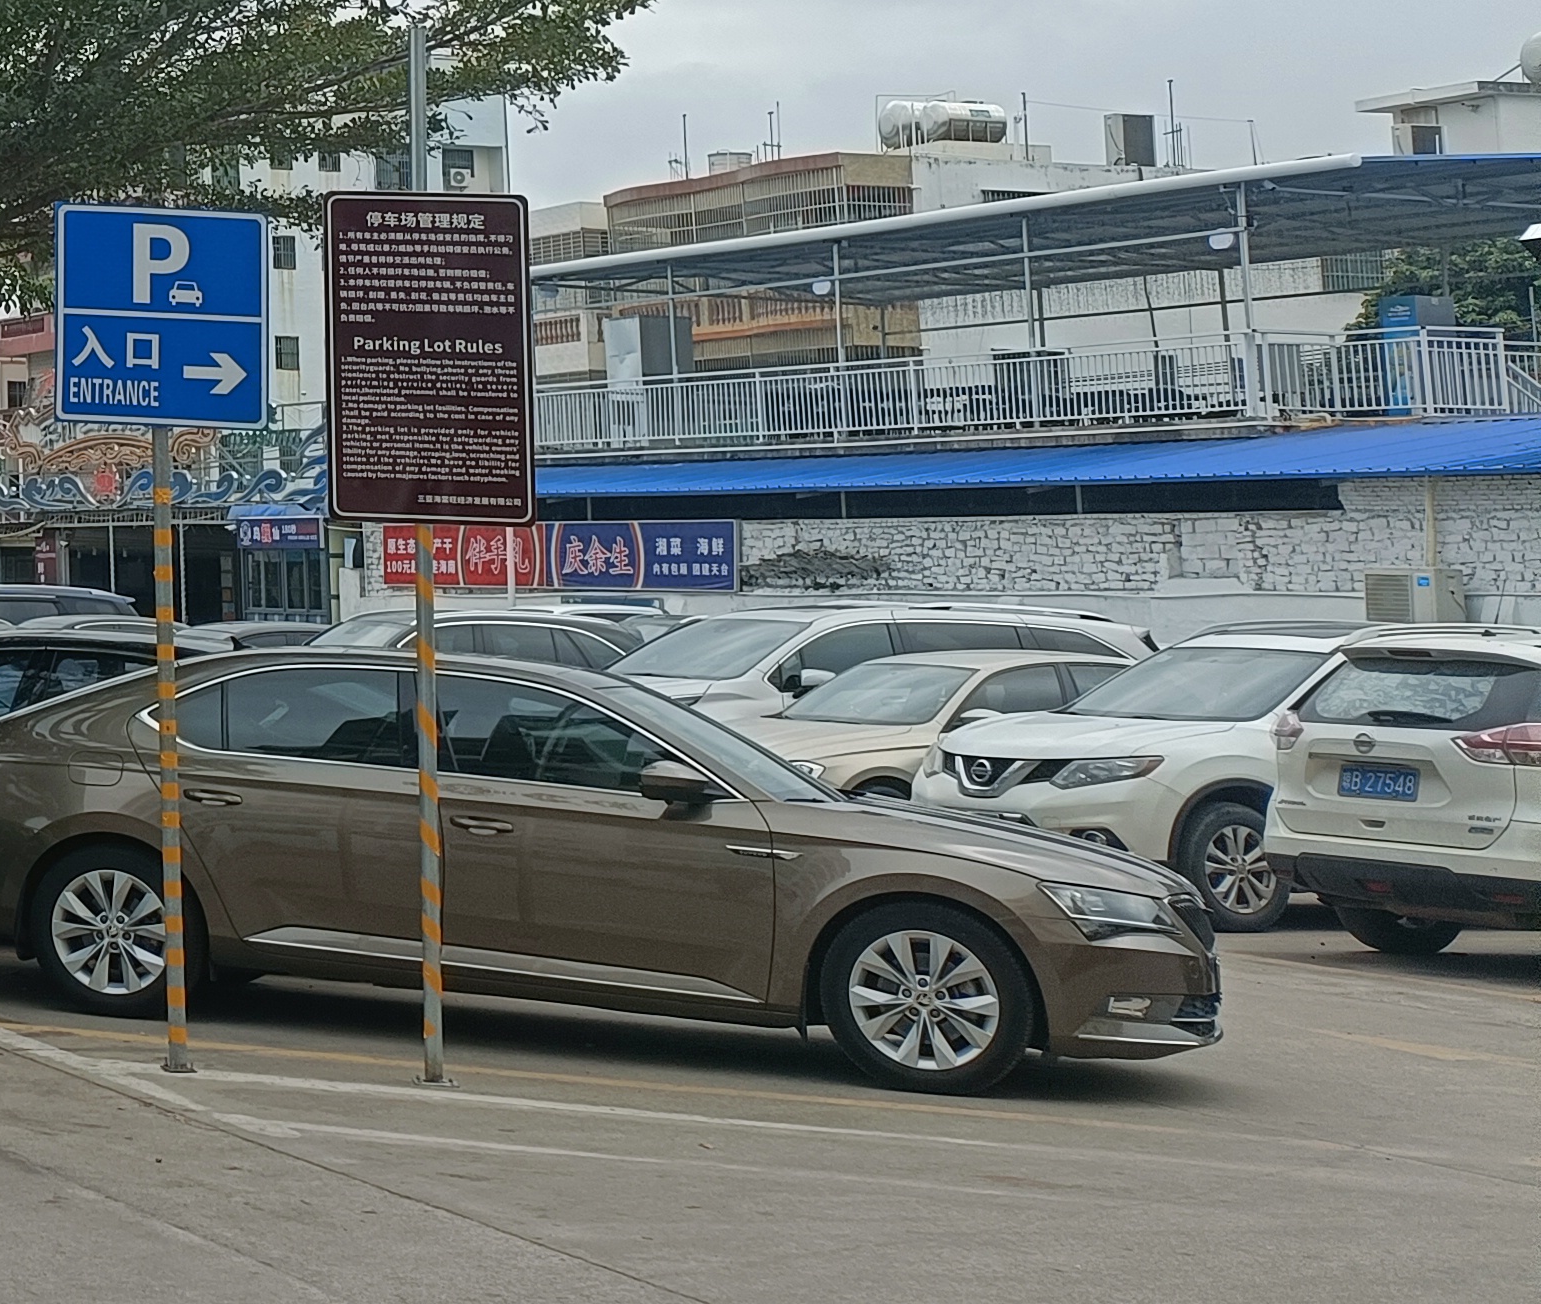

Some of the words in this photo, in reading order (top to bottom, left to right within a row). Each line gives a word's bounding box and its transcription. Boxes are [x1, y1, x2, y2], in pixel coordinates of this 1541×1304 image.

[366, 211, 485, 229] 停车场管理规定
[131, 223, 191, 304] P
[71, 325, 160, 370] 入口
[354, 337, 420, 354] Parking
[424, 338, 451, 352] Lot
[456, 339, 503, 354] Rules
[69, 377, 159, 408] ENTRANCE
[562, 534, 633, 575] 庆余生
[655, 537, 682, 556] 湘菜
[697, 537, 724, 556] 海鲜
